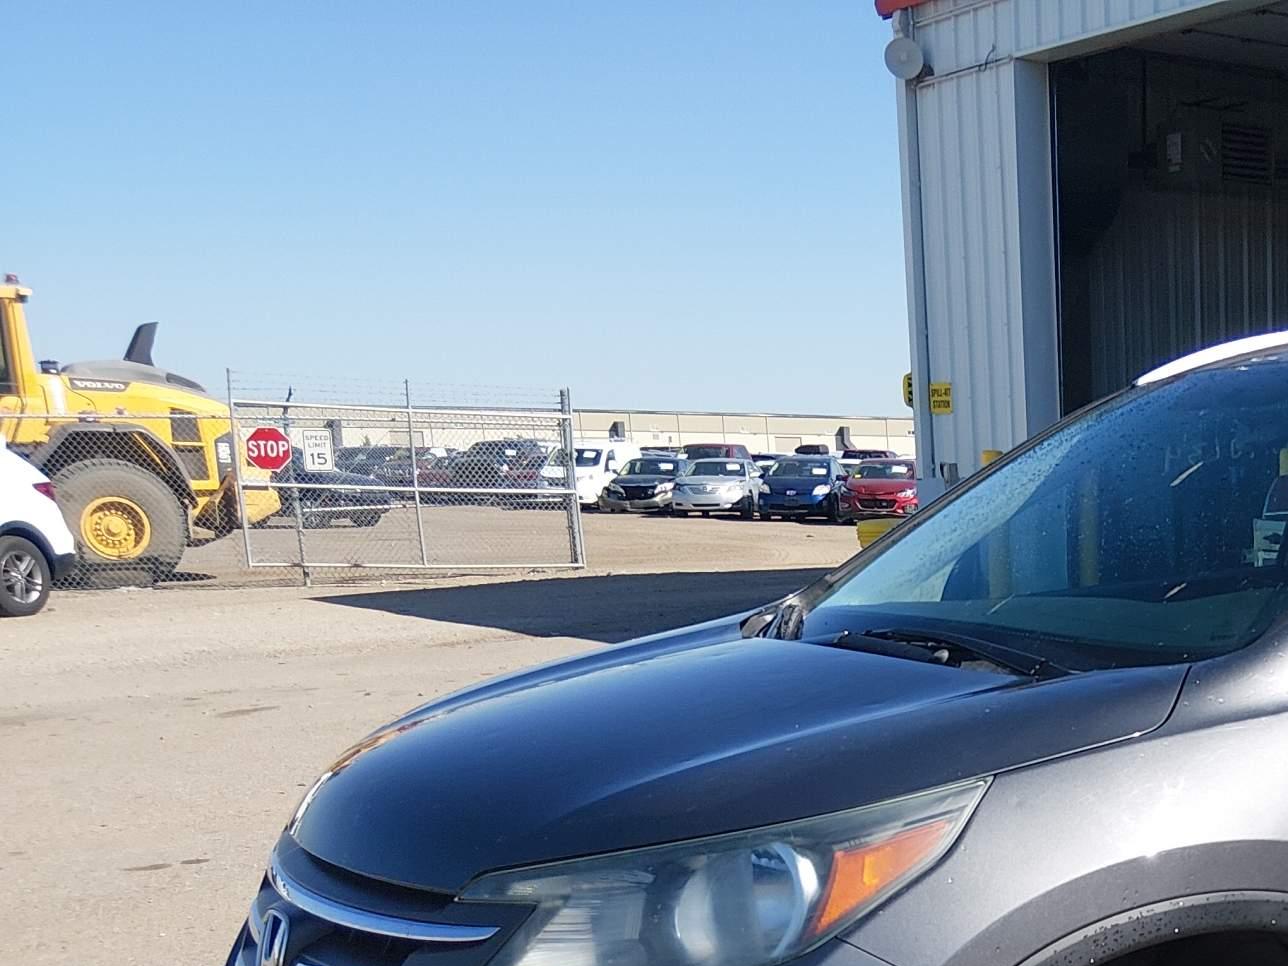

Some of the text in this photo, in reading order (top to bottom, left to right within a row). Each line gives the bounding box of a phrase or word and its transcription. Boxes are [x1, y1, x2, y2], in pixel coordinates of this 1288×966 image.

[73, 380, 126, 390] VOLVO
[248, 440, 289, 458] STOP
[310, 452, 328, 465] 15
